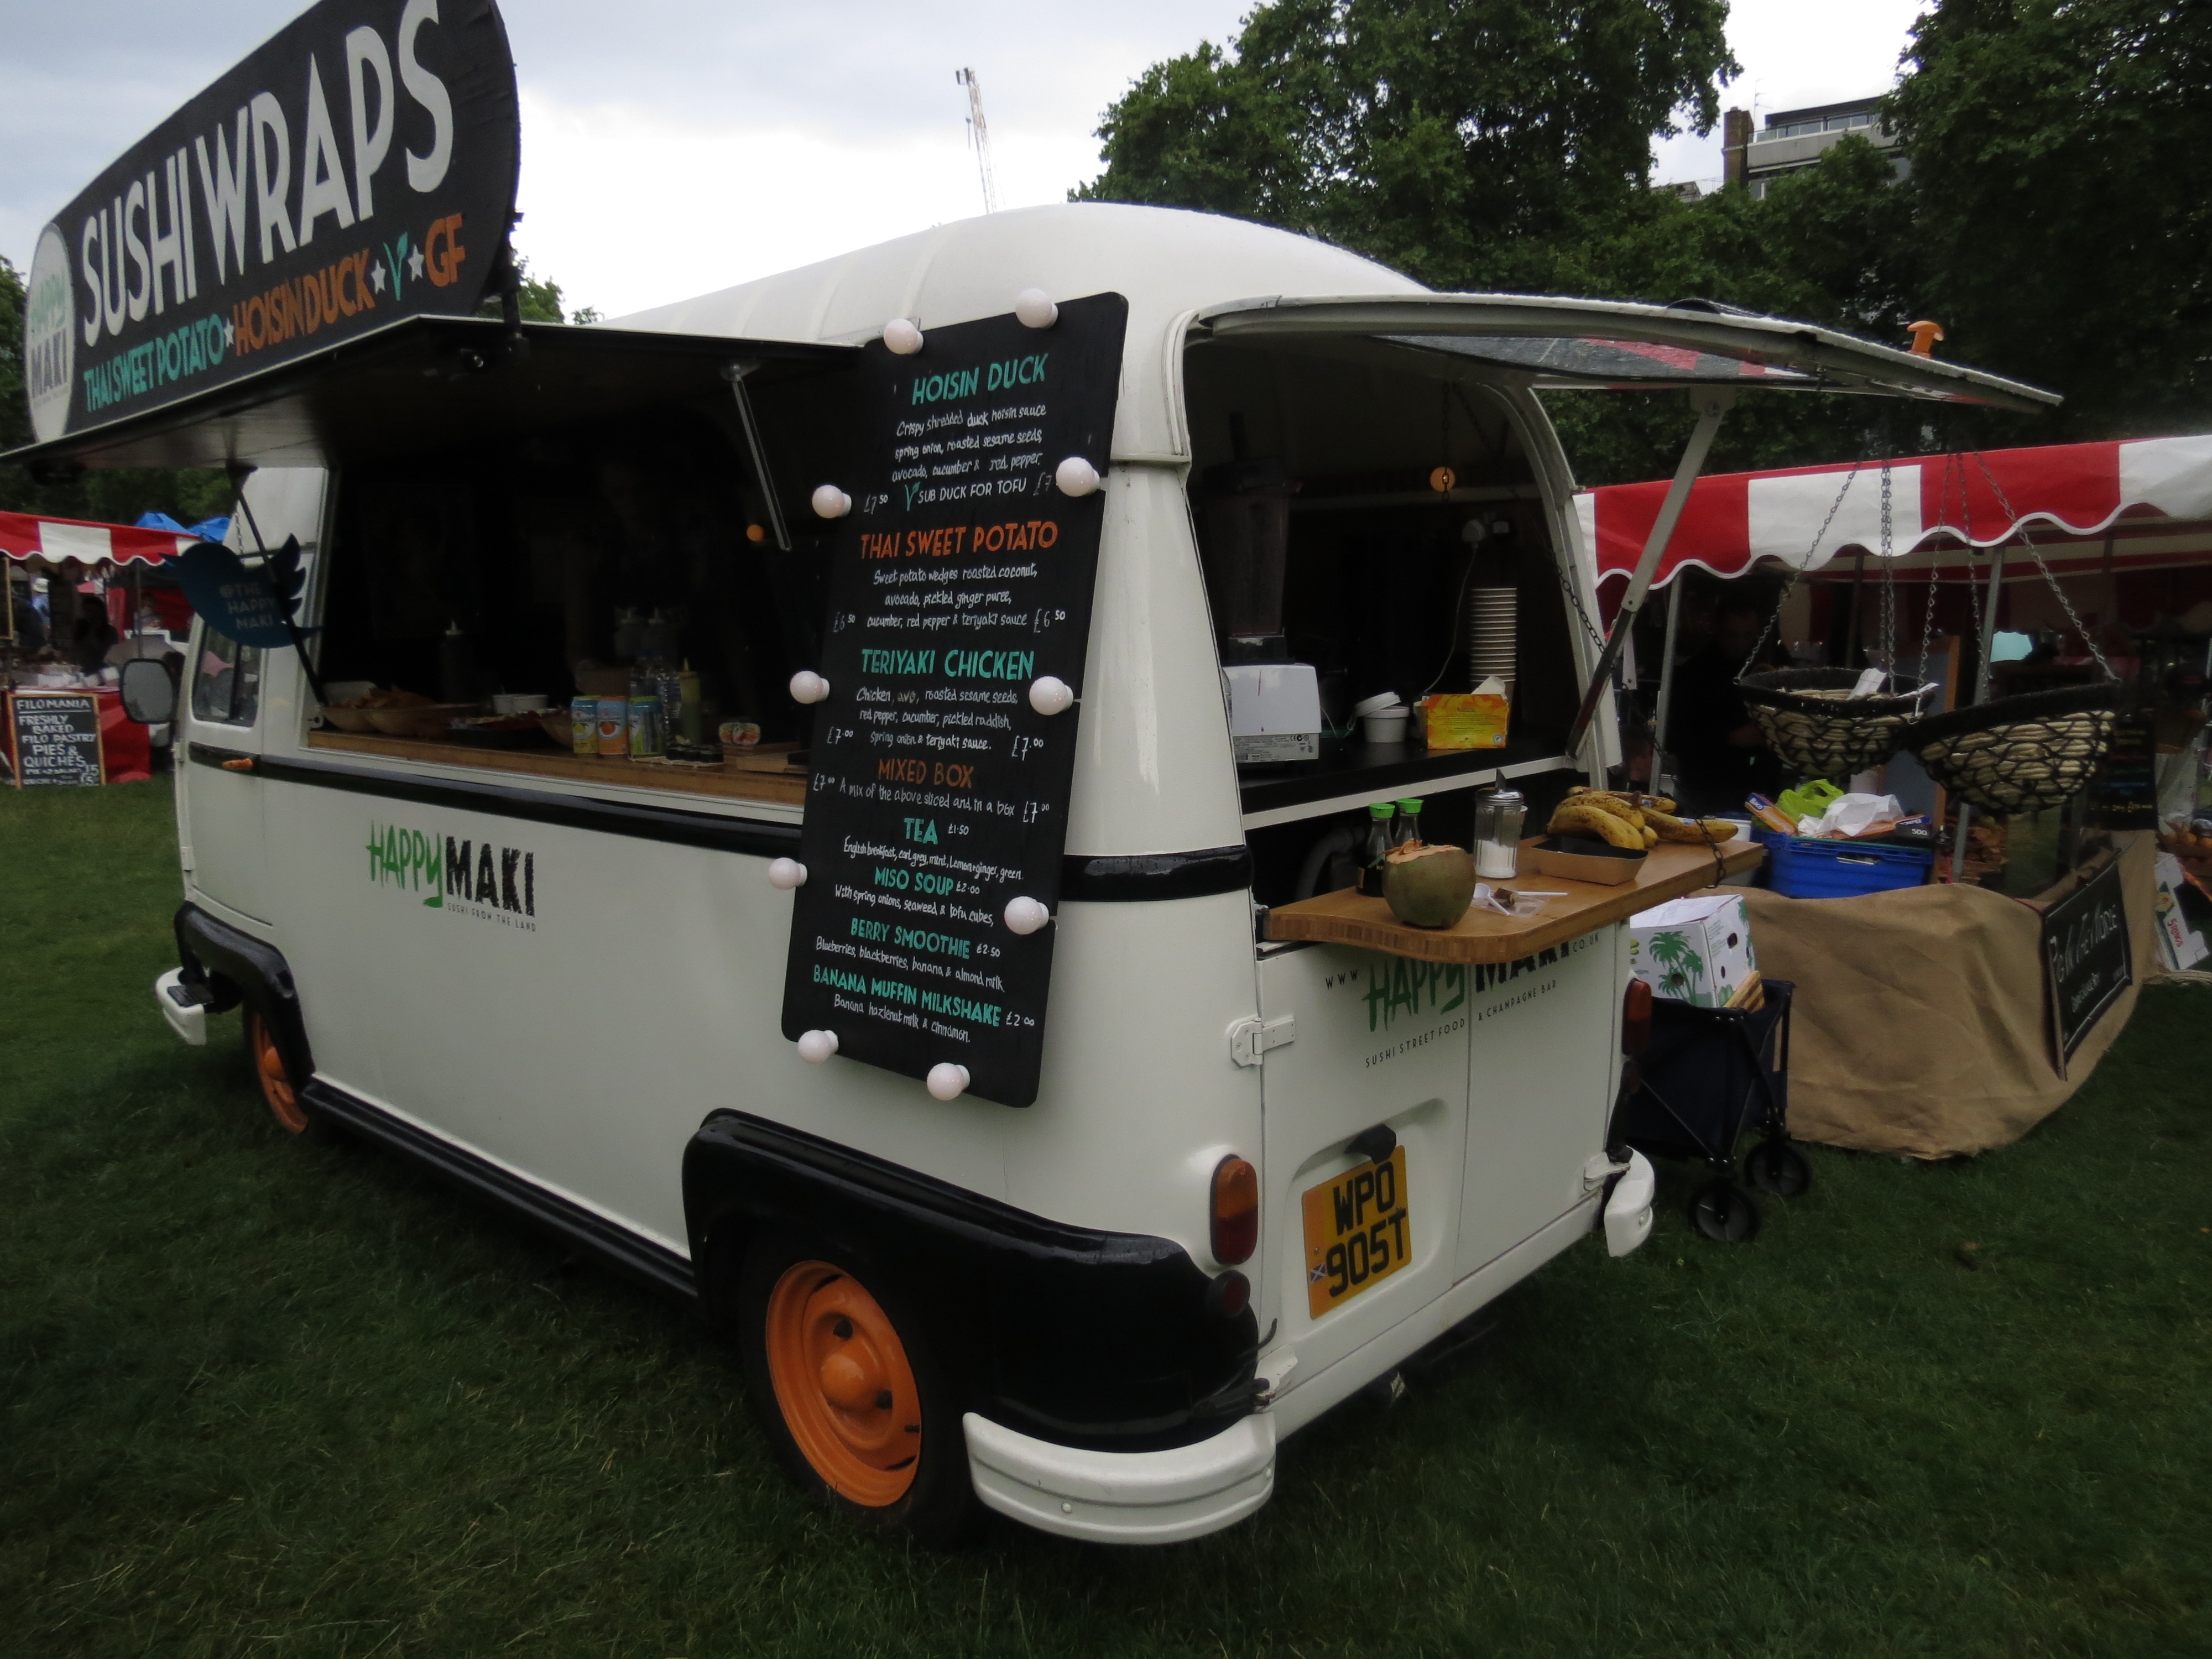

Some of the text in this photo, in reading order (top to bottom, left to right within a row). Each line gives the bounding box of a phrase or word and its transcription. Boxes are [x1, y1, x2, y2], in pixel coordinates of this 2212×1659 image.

[82, 0, 453, 347] SUSHI WRAPS
[84, 361, 112, 413] THAI
[111, 341, 154, 402] SWEET
[155, 313, 225, 386] POTATO
[233, 278, 306, 357] HOISIN
[302, 248, 375, 334] DUCK
[426, 212, 465, 287] GF
[912, 353, 1048, 405] HOISIN DUCK
[896, 404, 1046, 437] Crispy shredded duck hoisin sauce
[895, 428, 1042, 462] spring onion, roasted sesame seeds,
[892, 465, 927, 482] avocado,
[932, 460, 972, 476] cucumber
[974, 459, 979, 471] &
[989, 455, 1008, 471] red
[918, 489, 936, 504] SUB
[940, 486, 967, 501] DUCK
[971, 482, 992, 497] FOR
[997, 478, 1026, 494] TOFU
[861, 521, 1058, 559] THAI SWEET POTATO
[873, 562, 1037, 586] Sweet potato wedges roasted coconut,
[885, 590, 1011, 609] avocado, pickled ginger puree,
[867, 612, 1027, 630] cucumber, red pepper & teriyaki sauce
[862, 649, 1034, 680] TERIYAKI CHICKEN
[17, 699, 90, 709] FILOMANIA
[898, 691, 919, 704] avo,
[925, 687, 957, 701] roasted
[959, 691, 990, 703] sesame
[992, 690, 1018, 704] seeds,
[18, 715, 69, 726] FRESHLY
[32, 724, 75, 734] BAKED
[859, 708, 1011, 731] red pepper, cucumber, pickled raddish,
[22, 733, 96, 744] FILO PASTRY
[33, 744, 79, 756] PIES &
[870, 731, 991, 750] spring onion & teriyaki sauce.
[23, 756, 86, 768] QUICHES
[879, 759, 973, 788] MIXED BOX
[839, 777, 846, 793] A
[849, 785, 863, 797] mix
[866, 783, 876, 798] of
[879, 785, 891, 801] the
[894, 788, 922, 804] above
[924, 792, 950, 808] sliced
[974, 799, 982, 812] in
[987, 802, 993, 812] a
[997, 801, 1015, 817] box
[904, 818, 938, 844] TEA
[844, 835, 867, 858] English
[868, 841, 898, 861] breakfast,
[899, 849, 912, 860] earl
[910, 853, 928, 867] grey,
[929, 854, 948, 868] mint,
[1000, 869, 1024, 883] green.
[446, 836, 535, 918] MAKI
[875, 867, 953, 896] MISO SOUP
[447, 902, 536, 932] SUSHI FROM THE LAND
[836, 884, 994, 927] With spring onions, seaweed & tofu cubes,
[851, 918, 971, 959] BERRY SMOOTHIE
[816, 936, 856, 958] Blueberries,
[859, 945, 908, 971] blackberries,
[912, 957, 943, 977] banana
[946, 967, 952, 977] &
[956, 968, 984, 986] almond
[813, 964, 1001, 1027] BANANA MUFFIN MILKSHAKE
[834, 994, 970, 1042] Banana hazlenut milk & cinnamon.
[1365, 980, 1556, 1068] SUSHI STREET FOOD & CHAMPAGNE BAR
